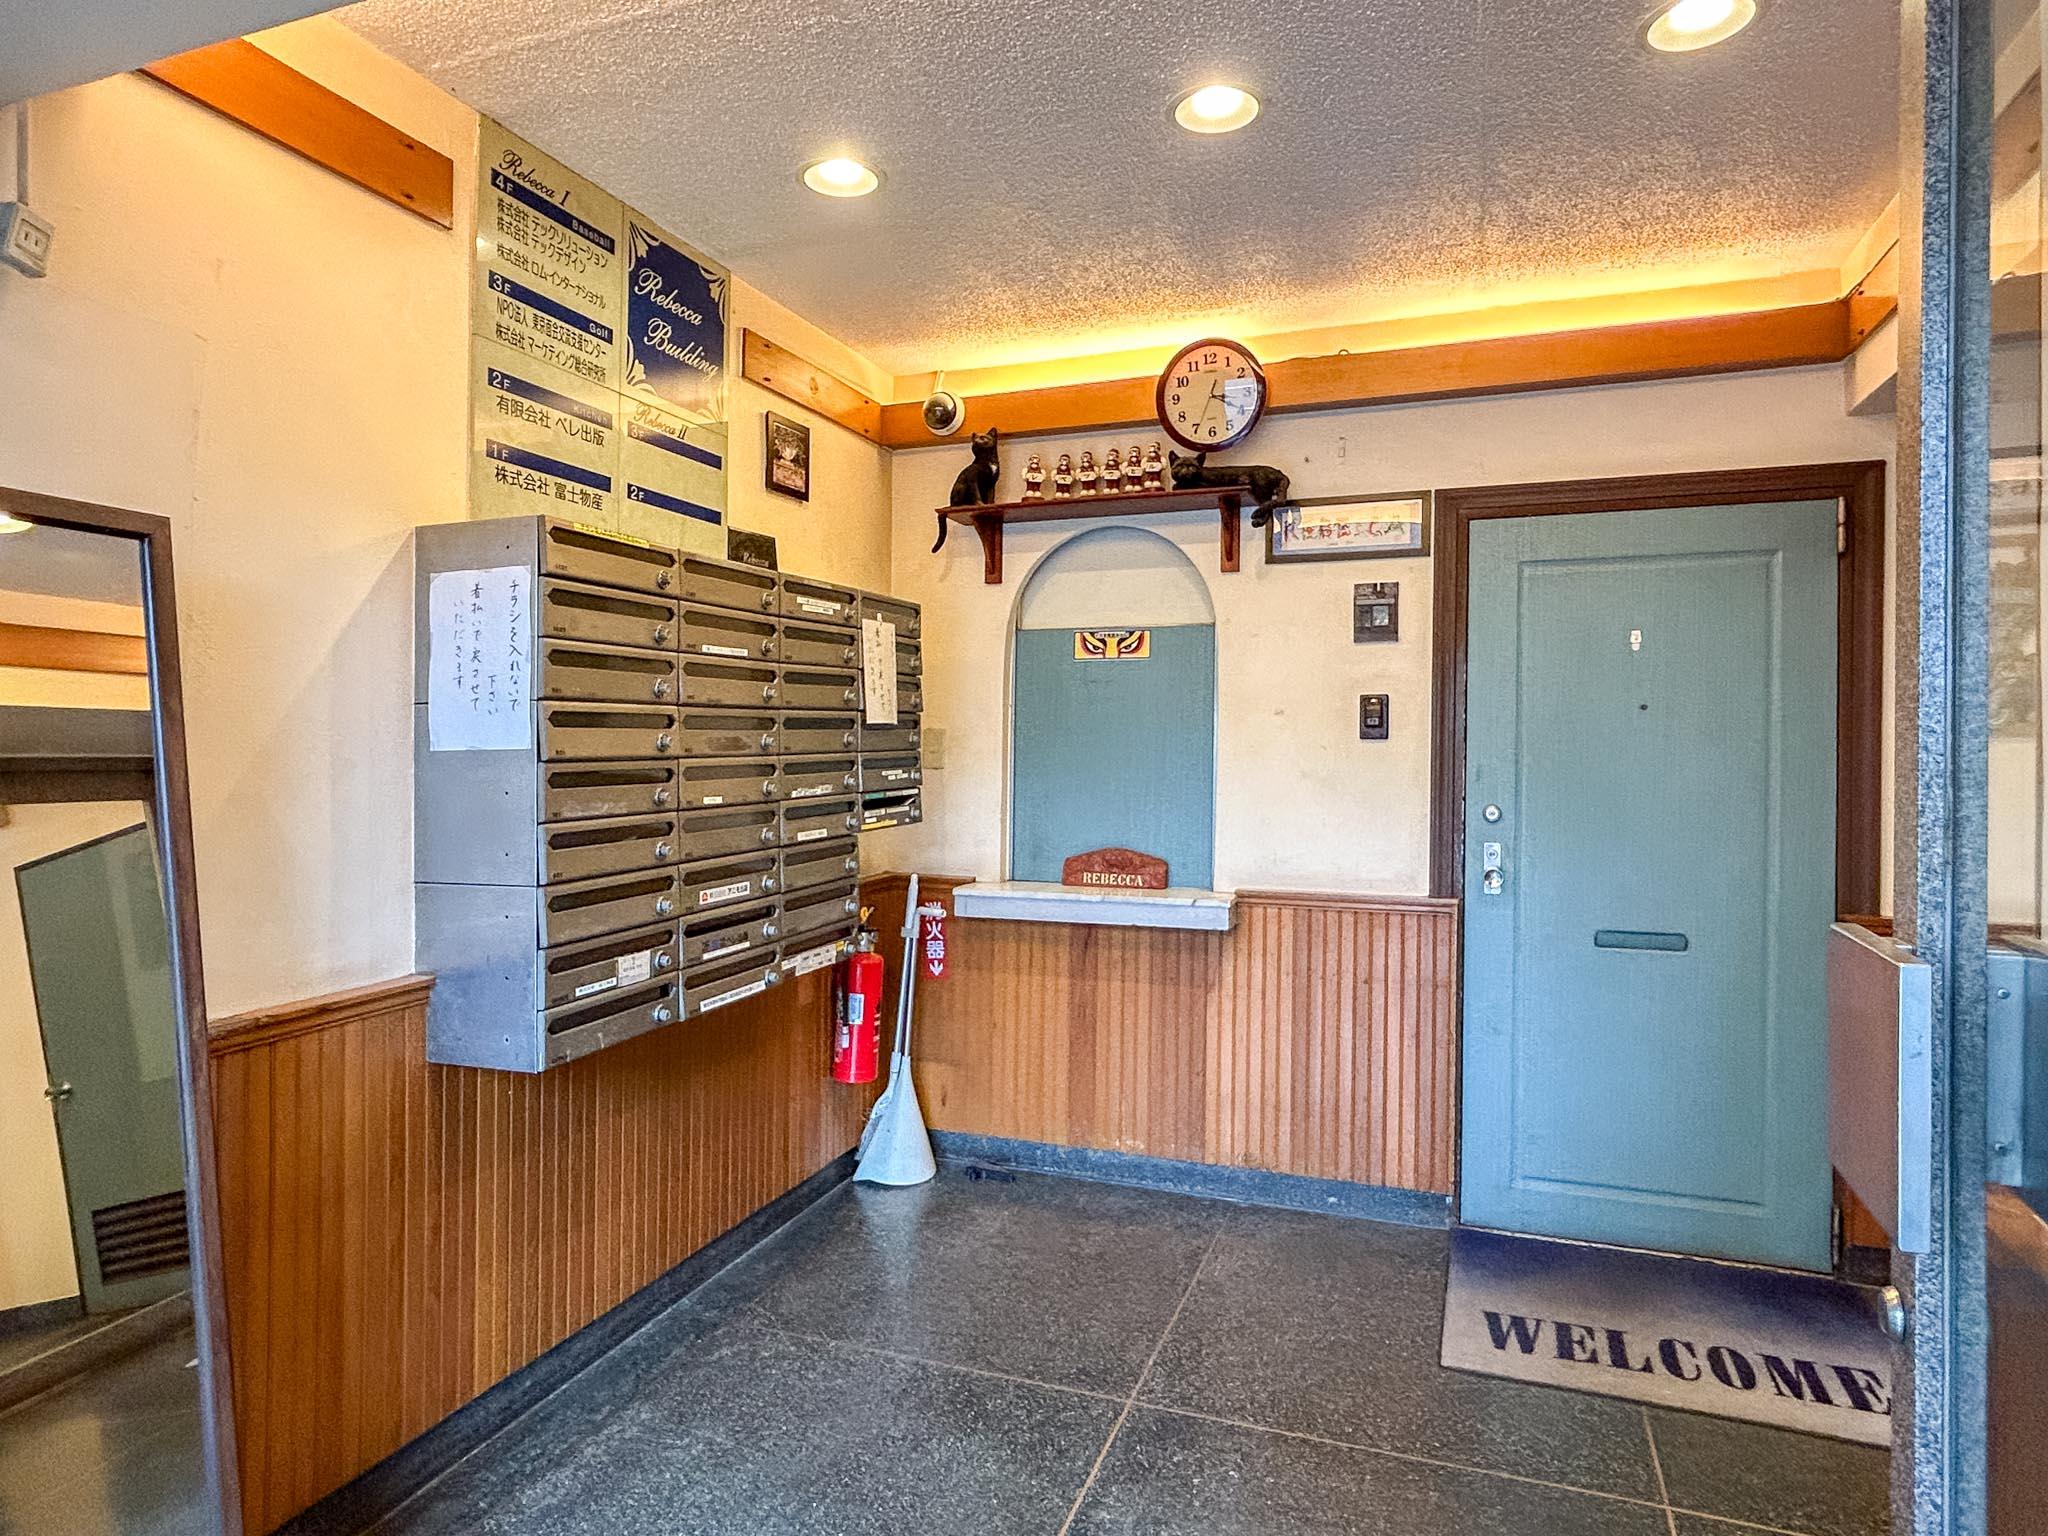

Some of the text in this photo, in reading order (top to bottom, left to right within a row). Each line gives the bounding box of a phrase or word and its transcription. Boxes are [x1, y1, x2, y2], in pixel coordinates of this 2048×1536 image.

[499, 149, 555, 198] Rebecca
[496, 175, 513, 193] 4F
[572, 219, 611, 249] Baseball
[493, 275, 511, 294] 3F
[634, 268, 703, 325] Rebecca
[589, 323, 609, 339] Golf
[644, 318, 719, 382] Building
[1203, 352, 1217, 365] 12
[1188, 361, 1200, 372] 11
[1225, 356, 1231, 368] 1
[493, 371, 511, 390] 2F
[1237, 367, 1245, 378] 2
[1176, 375, 1189, 388] 10
[1172, 394, 1180, 405] 9
[1243, 386, 1251, 397] 3
[496, 394, 552, 429] 有限会社
[634, 404, 676, 436] Rebecca
[1178, 411, 1186, 422] 8
[631, 425, 645, 439] 3F
[1192, 423, 1200, 435] 7
[1208, 426, 1217, 437] 6
[1226, 420, 1233, 431] 5
[492, 443, 509, 461] 1F
[495, 464, 603, 511] 株式会社 富士物産
[631, 486, 645, 500] 2F
[453, 600, 465, 689] いただきます
[508, 579, 523, 712] チラシを入れないで
[487, 675, 499, 715] 下さい
[1083, 871, 1144, 887] REBECCA
[1482, 1310, 1891, 1415] WELCOME
